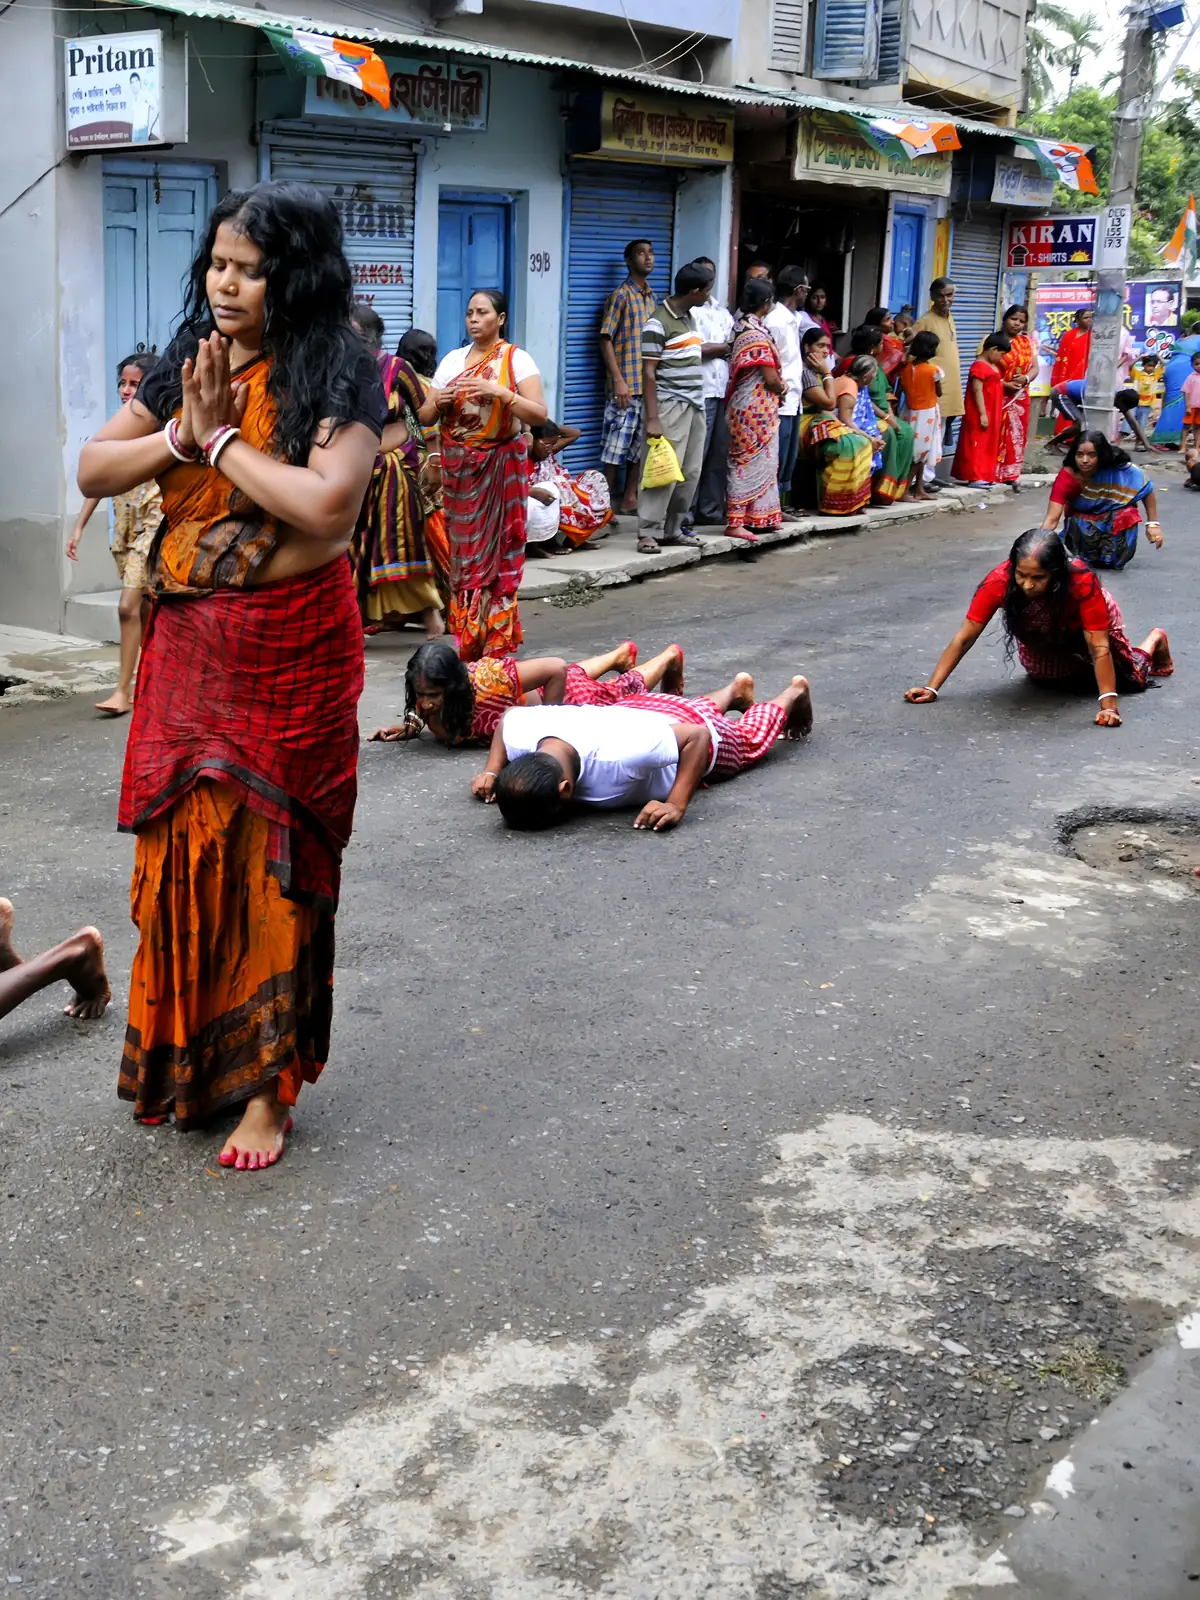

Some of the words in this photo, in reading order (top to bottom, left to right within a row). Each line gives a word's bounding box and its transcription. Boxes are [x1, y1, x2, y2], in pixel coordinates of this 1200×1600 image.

[69, 44, 155, 77] Pritam
[335, 185, 407, 238] itam
[1108, 208, 1126, 218] DEC
[1111, 218, 1122, 227] 13
[1011, 224, 1093, 244] KIRAN
[1107, 228, 1122, 236] 155
